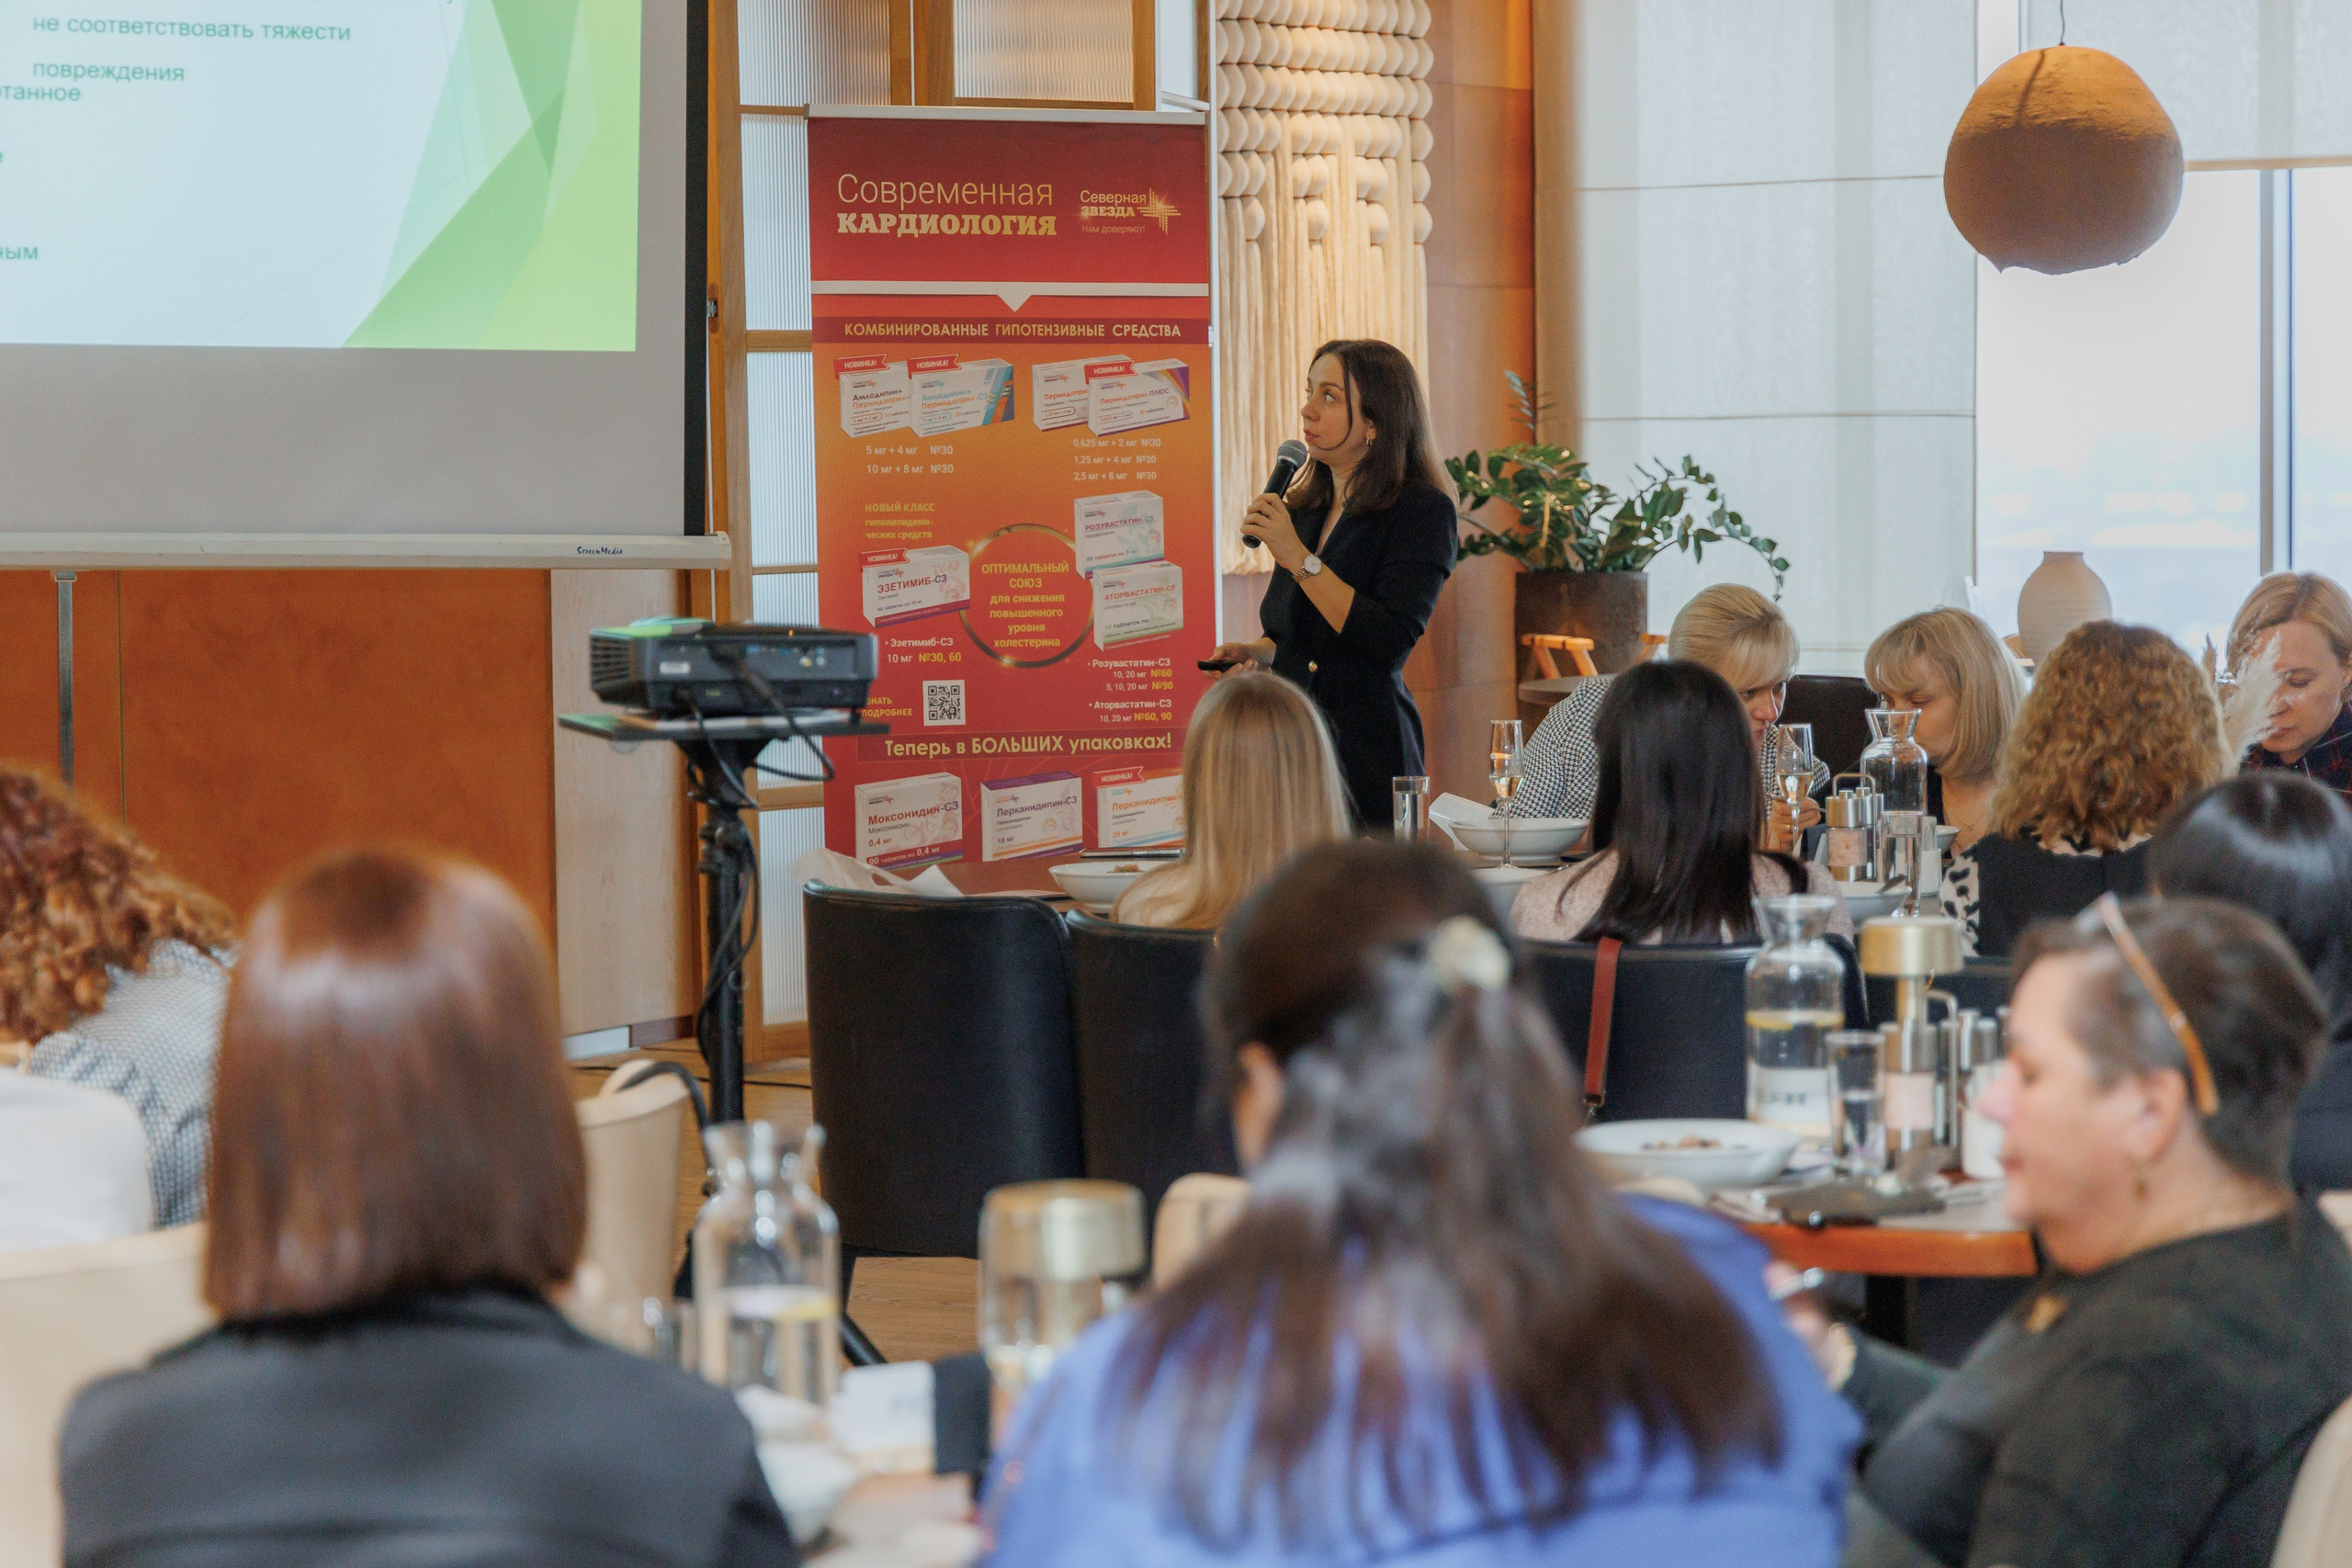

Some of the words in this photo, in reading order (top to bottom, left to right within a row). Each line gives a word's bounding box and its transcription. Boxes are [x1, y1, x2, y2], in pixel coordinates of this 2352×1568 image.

[33, 17, 59, 31] не
[67, 18, 254, 38] соответствовать
[261, 23, 351, 40] тяжести
[33, 62, 185, 82] повреждения
[0, 85, 81, 102] танное
[837, 174, 1053, 211] Современная
[1080, 189, 1147, 206] Северная
[1080, 206, 1136, 218] ЗВЕЗДА
[837, 213, 1057, 238] КАРДИОЛОГИЯ
[1081, 225, 1100, 233] Нам
[1102, 225, 1146, 234] доверяют!
[844, 323, 989, 336] КОМБИНИРОВАННЫЕ
[995, 324, 1105, 337] ГИПОТЕНЗИВНЫЕ
[1113, 324, 1182, 338] СРЕДСТВА
[843, 359, 877, 368] НОВИНКА!
[916, 359, 949, 368] НОВИНКА!
[1093, 366, 1125, 375] НОВИНКА!
[853, 389, 902, 401] Амлодипин+
[1044, 389, 1088, 400] Периндопри
[1100, 393, 1148, 404] Периндоприл
[1149, 388, 1170, 397] ПЛЮС
[853, 396, 910, 410] Периндоприл-
[1073, 439, 1096, 448] 0,625
[1141, 438, 1161, 447] №30
[865, 446, 872, 455] 5
[875, 447, 887, 456] мг
[898, 446, 903, 455] 4
[906, 447, 918, 456] мг
[930, 446, 954, 455] №30
[1074, 456, 1091, 465] 1,25
[1114, 456, 1119, 464] 4
[1136, 456, 1156, 464] №30
[866, 464, 878, 474] 10
[881, 466, 893, 474] мг
[903, 464, 910, 474] 8
[911, 466, 924, 474] мг
[930, 464, 954, 473] №30
[1074, 472, 1086, 481] 2,5
[1108, 472, 1114, 480] 8
[1136, 471, 1156, 480] №30
[865, 501, 900, 513] НОВЫЙ
[903, 502, 935, 512] КЛАСС
[865, 519, 933, 527] гиполипидеми-
[865, 531, 896, 539] ческих
[898, 531, 933, 540] средств
[576, 546, 623, 556] ScreenMedia
[867, 553, 898, 562] НОВИНКА!
[981, 560, 1069, 574] ОПТИМАЛЬНЫЙ
[877, 574, 947, 593] ЭЗЕТИМИБ-СЗ
[1009, 578, 1042, 588] СОЮЗ
[989, 595, 1010, 605] для
[1012, 594, 1065, 604] снижения
[989, 609, 1063, 618] повышенного
[1008, 624, 1046, 635] уровня
[890, 637, 954, 648] Эзетимиб-СЗ
[994, 638, 1061, 649] холестерина
[888, 654, 899, 663] 10
[900, 655, 912, 663] мг
[919, 652, 946, 664] №30,
[948, 652, 961, 661] 60
[1092, 658, 1170, 670] Розувастатин-СЗ
[1114, 671, 1125, 680] 10,
[1125, 671, 1136, 679] 20
[1150, 669, 1172, 678] №60
[1114, 682, 1125, 691] 10,
[1126, 682, 1136, 691] 20
[1151, 682, 1173, 690] №90
[867, 697, 892, 705] ЗНАТЬ
[1094, 699, 1172, 711] Аторвастатин-СЗ
[861, 708, 912, 718] ПОДРОБНЕЕ
[1100, 715, 1110, 724] 10,
[1134, 712, 1159, 723] №60,
[1160, 713, 1172, 721] 90
[885, 740, 951, 759] Теперь
[956, 742, 966, 754] в
[971, 735, 1064, 754] БОЛЬШИХ
[1069, 732, 1172, 755] упаковках!
[1102, 773, 1133, 783] НОВИНКА!
[996, 795, 1078, 818] Лерканидипин-СЗ
[1112, 793, 1184, 811] Лерканидипин-
[868, 800, 959, 825] Моксонидин-СЗ
[868, 822, 910, 834] Моксонидин
[868, 838, 881, 847] 0,4
[916, 847, 929, 856] 0,4
